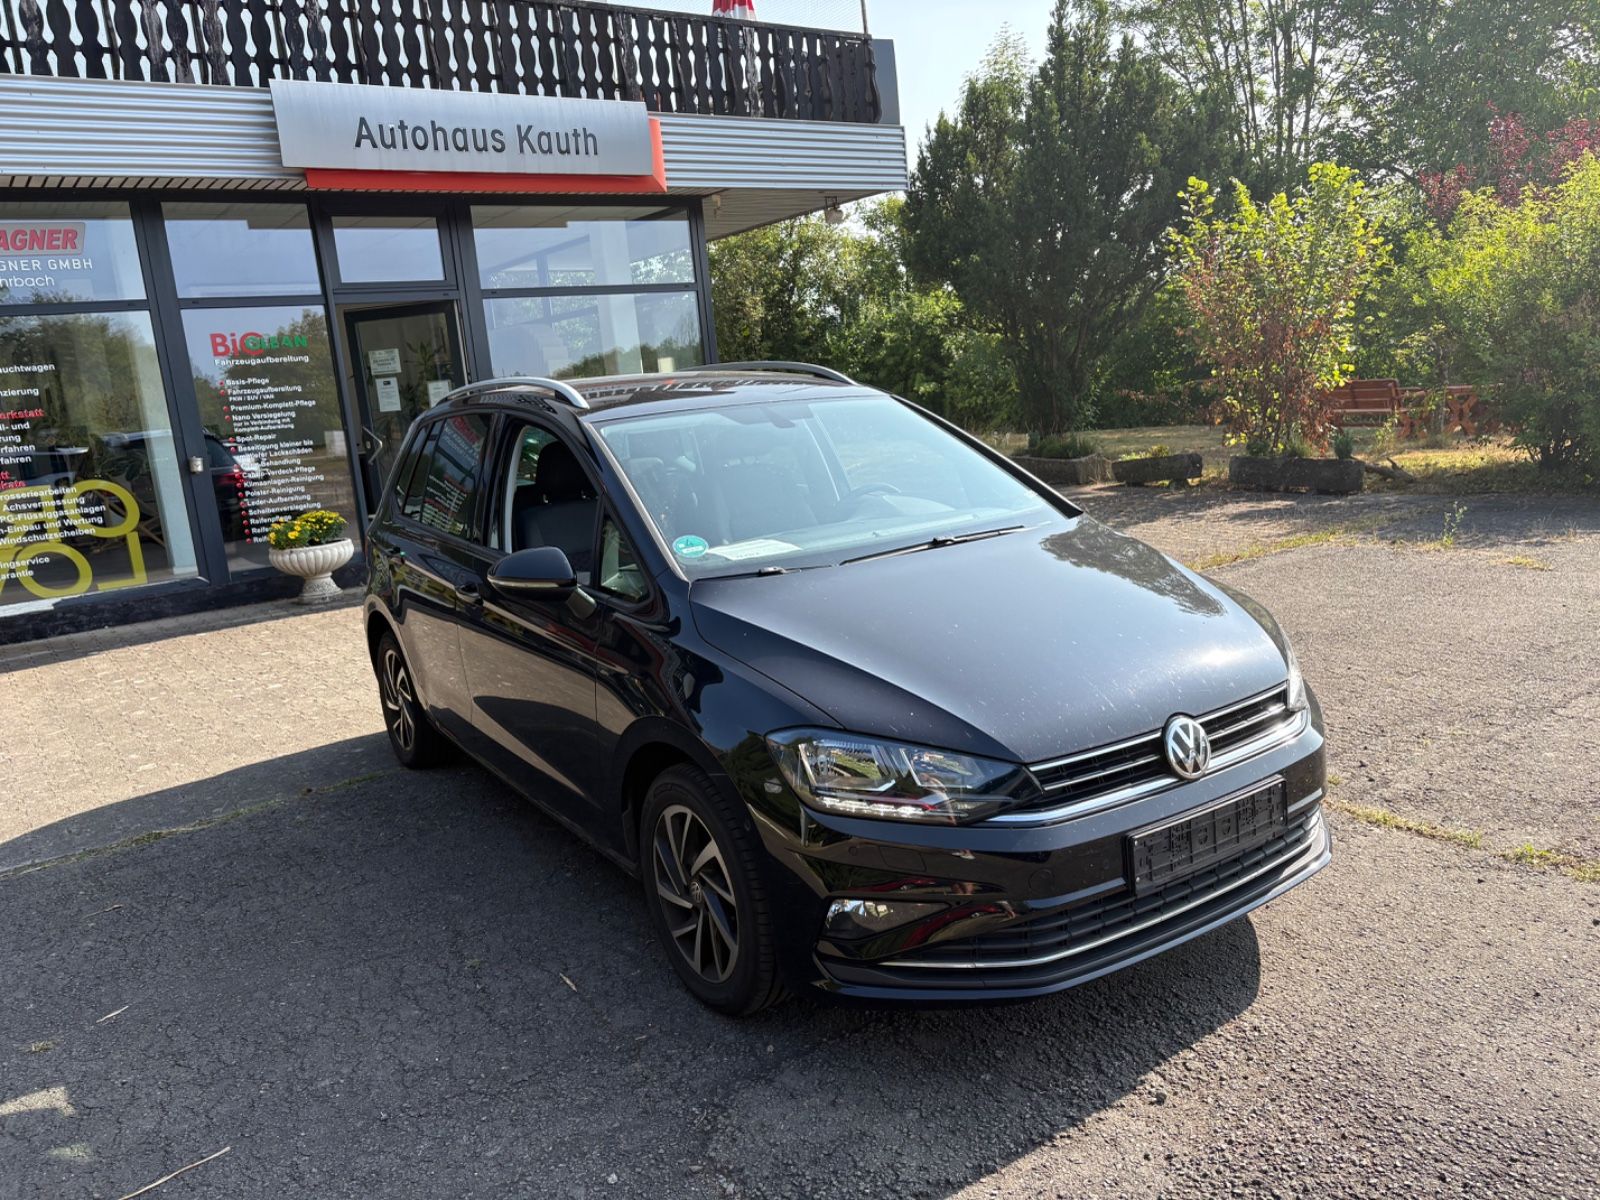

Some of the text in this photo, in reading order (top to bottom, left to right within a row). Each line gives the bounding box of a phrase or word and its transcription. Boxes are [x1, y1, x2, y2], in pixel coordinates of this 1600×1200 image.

[354, 116, 599, 156] Autohaus Kauth
[48, 258, 93, 270] GMBH
[214, 355, 309, 366] Fahrzeugaufbereitung
[11, 421, 30, 430] und
[2, 496, 85, 512] Achsvermessung
[43, 518, 62, 529] und
[63, 516, 103, 527] Wartung
